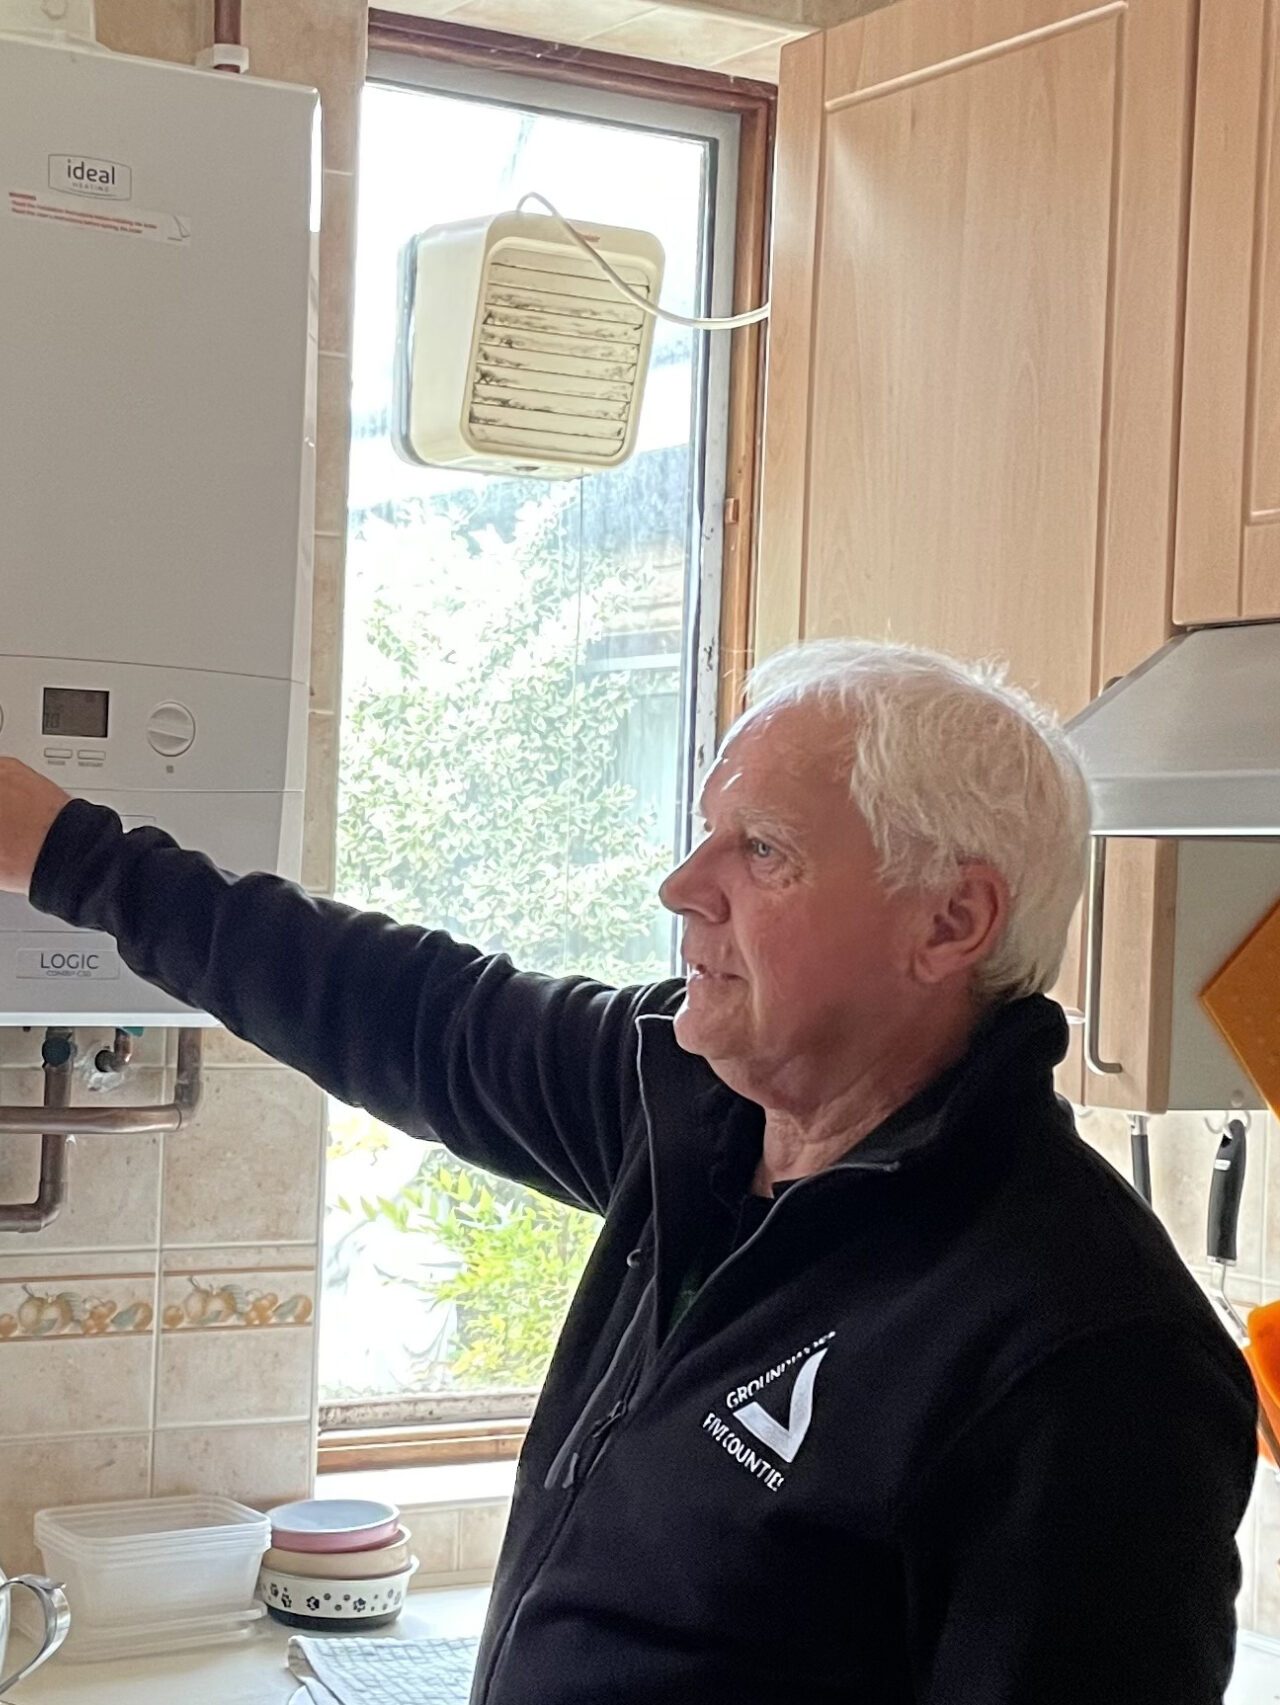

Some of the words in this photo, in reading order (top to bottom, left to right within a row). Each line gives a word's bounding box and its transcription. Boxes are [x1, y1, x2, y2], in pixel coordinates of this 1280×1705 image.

[67, 158, 115, 185] ideal
[40, 952, 99, 970] LOGIC
[725, 1331, 837, 1409] GROUN
